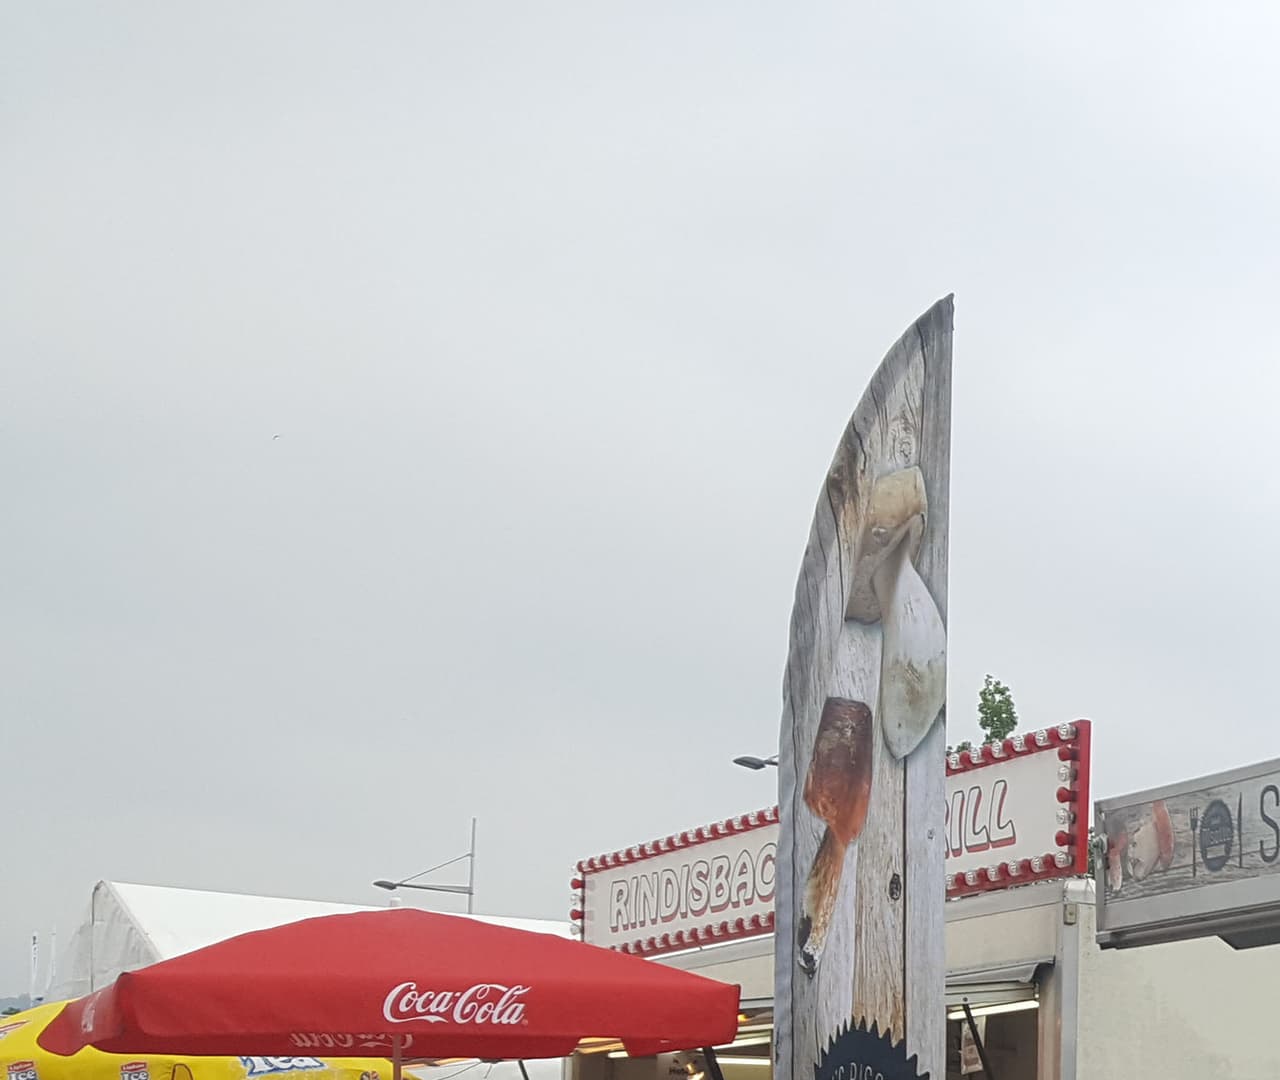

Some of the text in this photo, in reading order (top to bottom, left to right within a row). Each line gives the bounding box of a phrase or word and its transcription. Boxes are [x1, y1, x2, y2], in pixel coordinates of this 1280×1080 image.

[610, 779, 1017, 933] RINDISBAC ILL
[382, 981, 533, 1025] Coca-Cola
